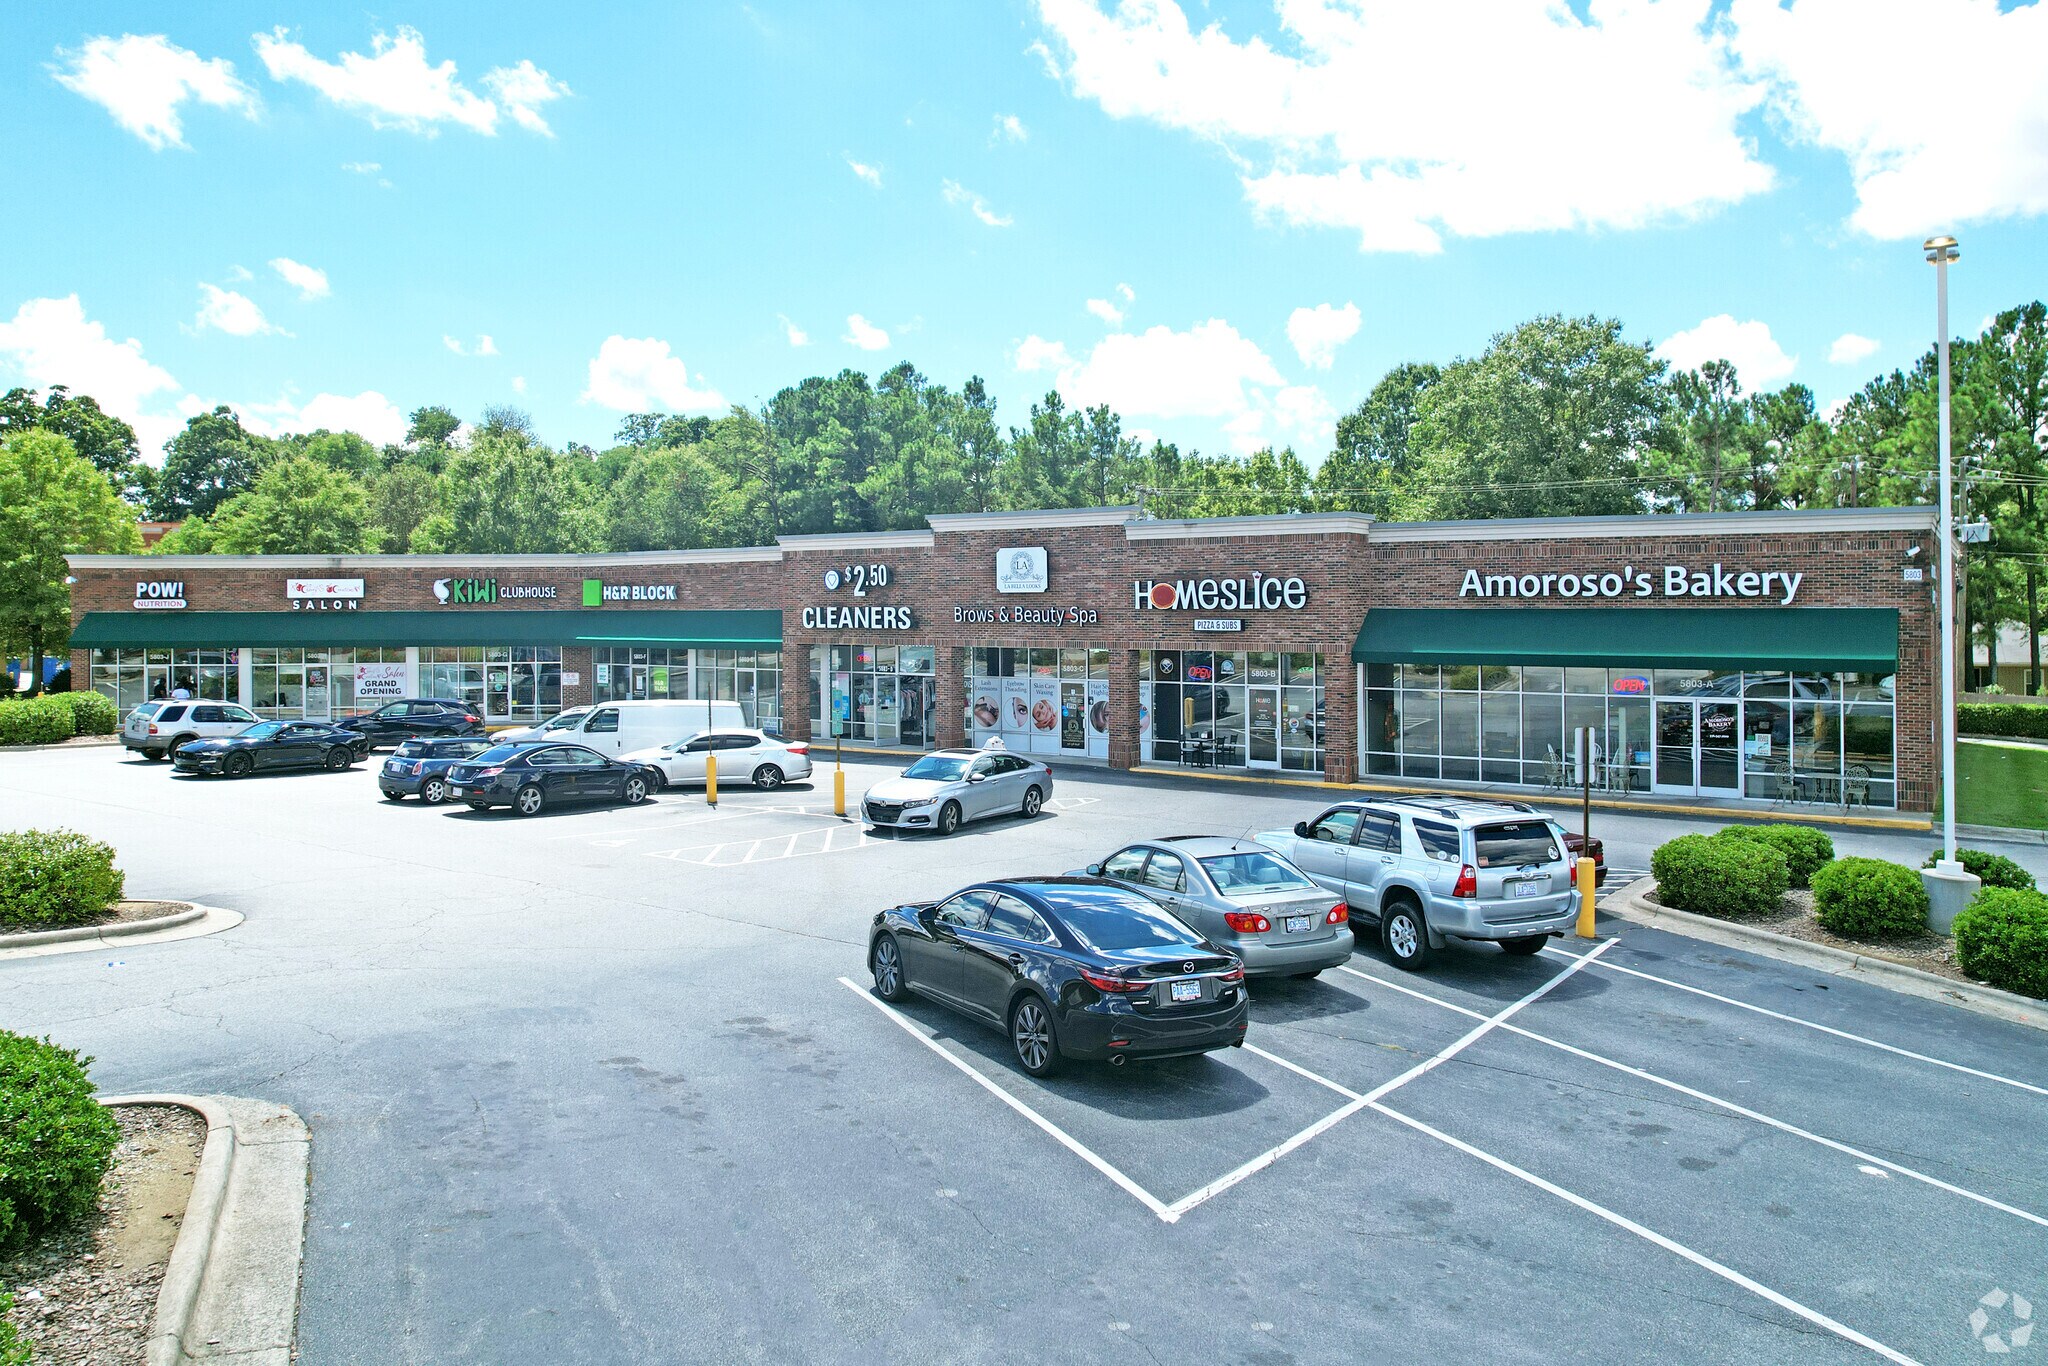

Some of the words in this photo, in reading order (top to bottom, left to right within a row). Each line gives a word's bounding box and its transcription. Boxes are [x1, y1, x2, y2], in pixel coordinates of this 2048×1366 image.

[1905, 570, 1922, 579] 5803
[136, 582, 184, 598] POW!
[1458, 565, 1654, 598] Amoroso's
[1664, 563, 1803, 605] Bakery
[500, 586, 557, 598] CLUBHOUSE
[603, 585, 630, 600] H&R
[632, 585, 677, 600] BLOCK
[292, 600, 357, 610] SALON
[802, 606, 911, 630] CLEANERS
[954, 606, 995, 622] Brows
[999, 606, 1010, 622] &
[1014, 606, 1065, 627] Beauty
[1069, 606, 1097, 627] Spa
[1197, 621, 1215, 629] PIZZA
[1221, 621, 1238, 629] SUBS
[382, 666, 405, 679] Salon
[1188, 666, 1212, 679] OPEN
[1613, 678, 1646, 692] OPEN
[1680, 679, 1714, 688] 5803-A
